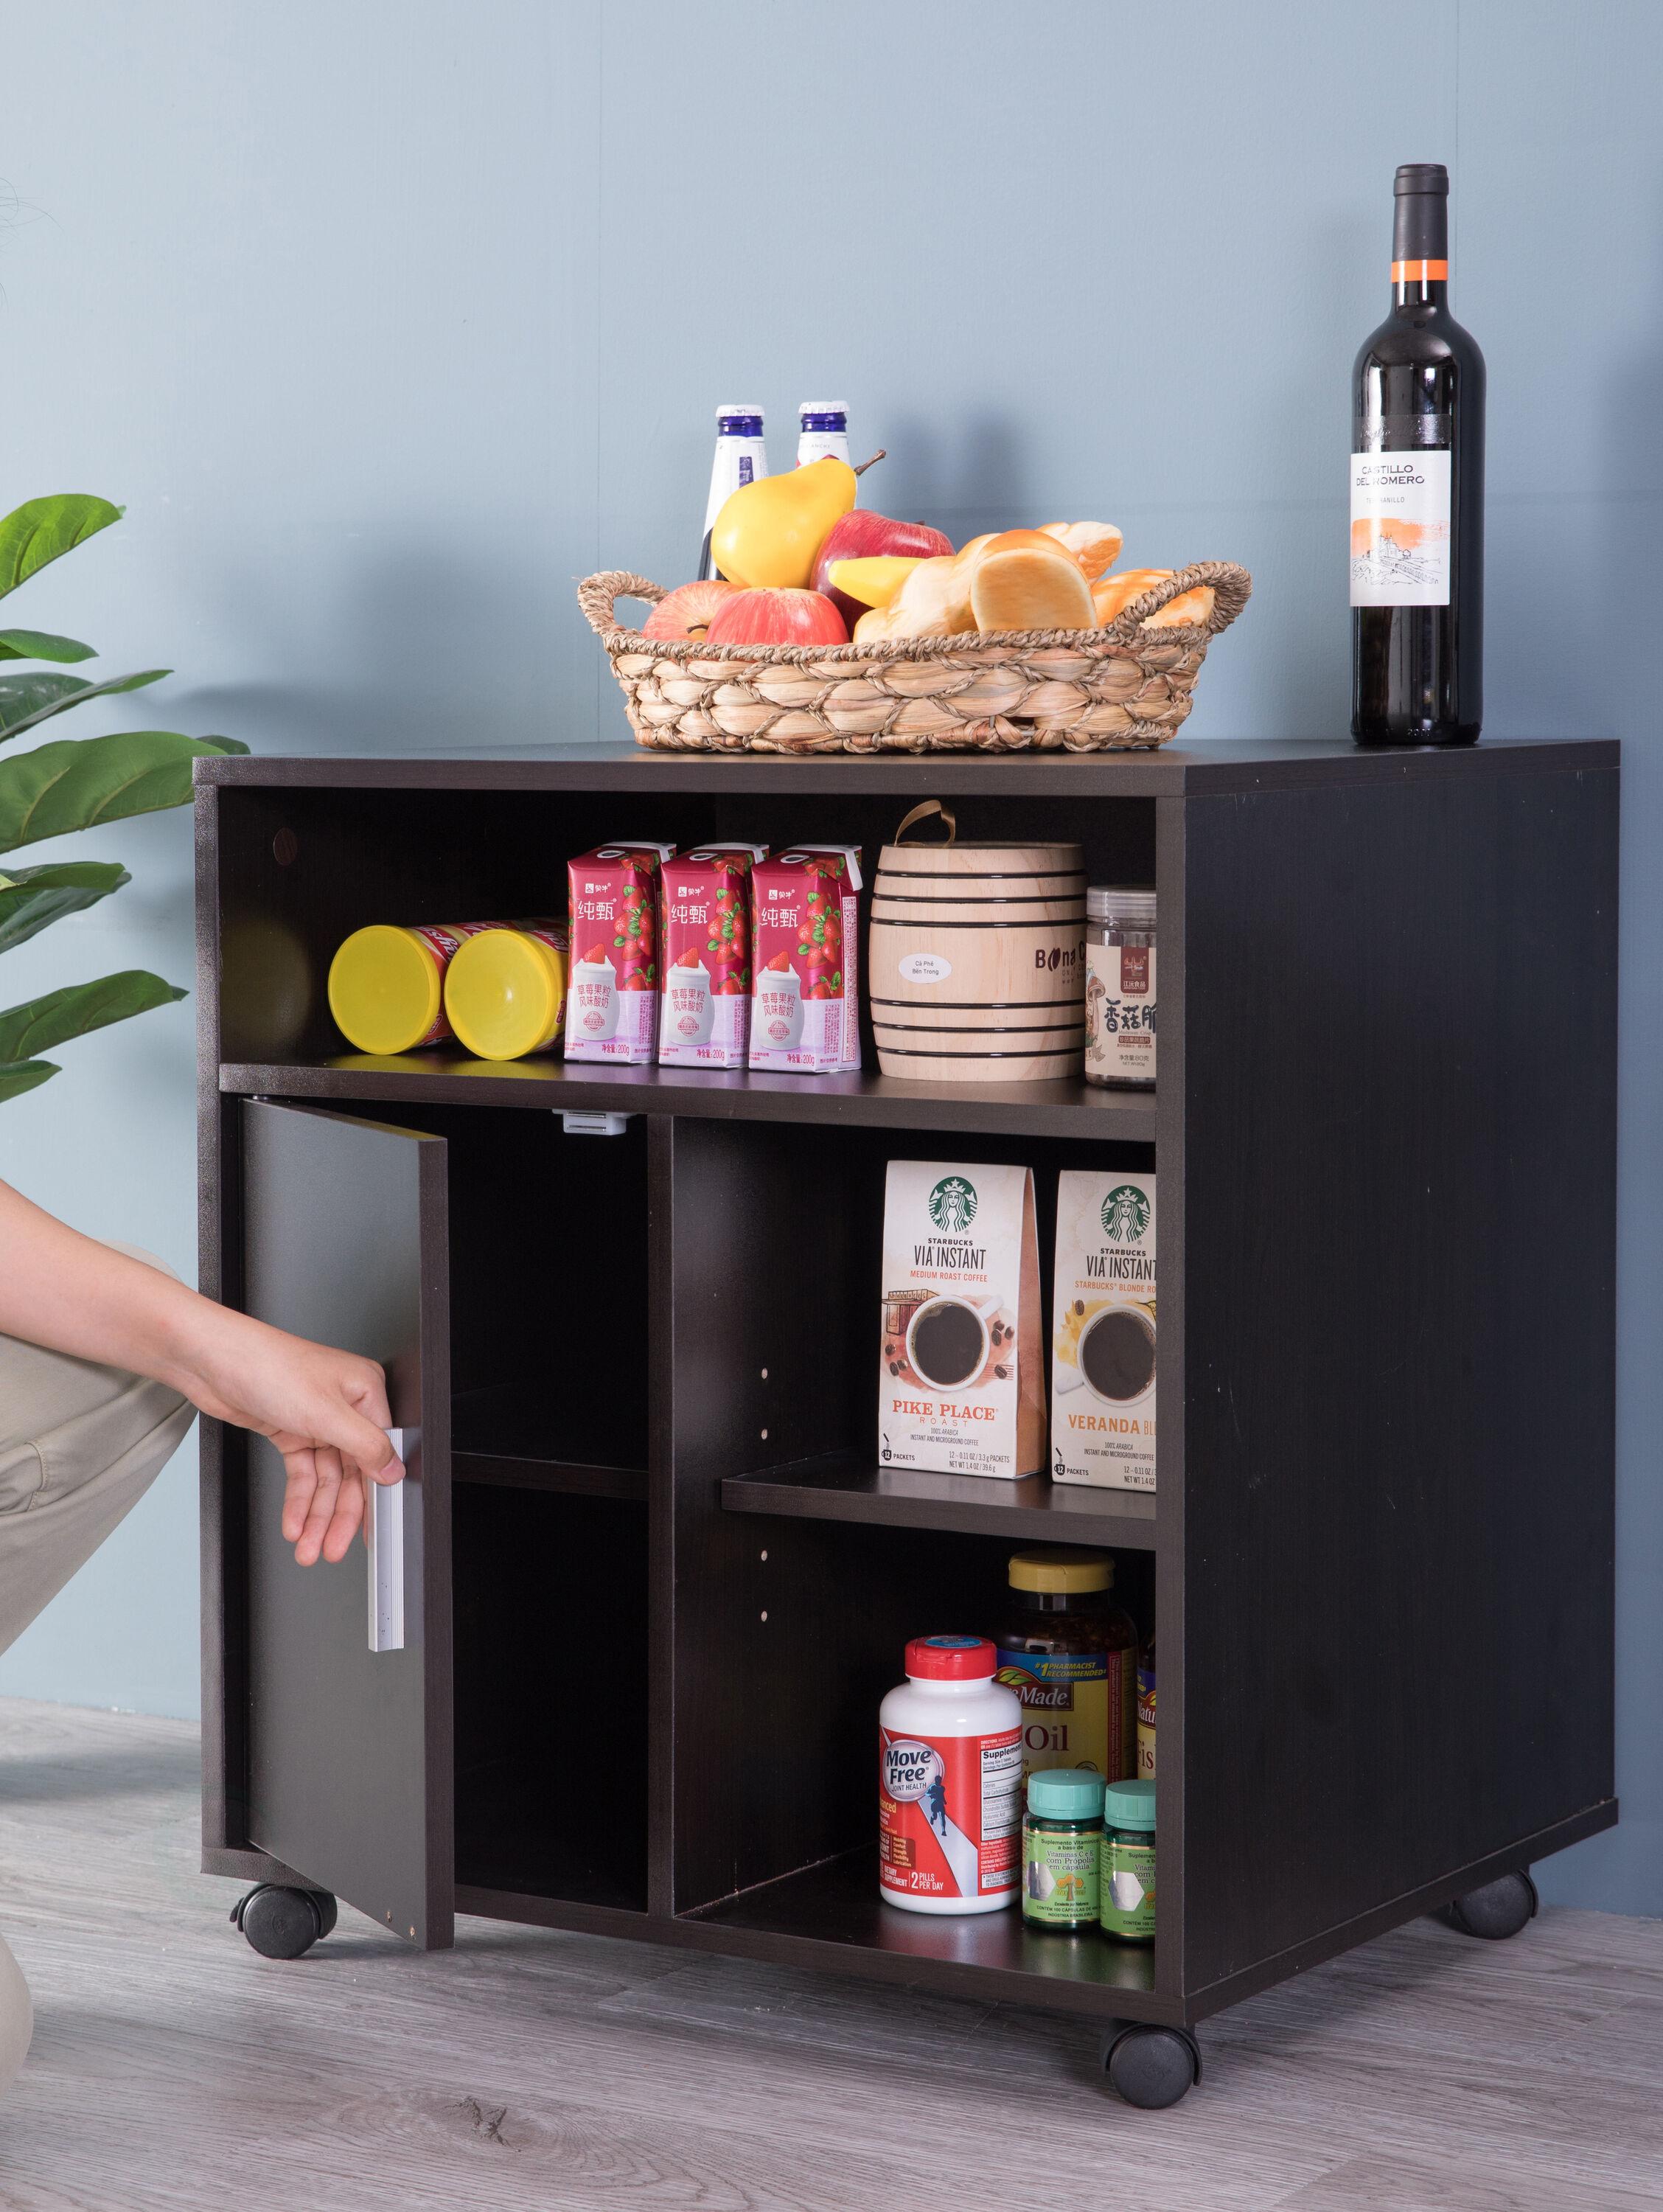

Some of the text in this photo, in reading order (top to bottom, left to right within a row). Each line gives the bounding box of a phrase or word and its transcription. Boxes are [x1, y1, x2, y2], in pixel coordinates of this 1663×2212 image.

[1356, 478, 1370, 486] DEL
[577, 900, 615, 920] 纯甄
[671, 904, 708, 925] 纯甄
[761, 908, 798, 928] 纯甄
[577, 984, 611, 998] 草莓果粒
[671, 989, 705, 1002] 草莓果粒
[579, 996, 609, 1009] 风味酸奶
[761, 992, 796, 1006] 草莓果粒
[674, 1001, 703, 1013] 风味酸奶
[764, 1004, 794, 1018] 风味酸奶
[928, 1238, 973, 1246] STARBUCKS
[914, 1245, 986, 1270] VIA INSTANT
[1100, 1248, 1146, 1256] STARBUCKS
[1087, 1255, 1105, 1278] VIA
[910, 1270, 988, 1282] MEDIUM ROAST COFFEE
[1075, 1281, 1114, 1290] STARBUCKS
[1119, 1284, 1145, 1293] BLONDE
[893, 1399, 995, 1421] PIKE PLACE
[920, 1416, 968, 1427] ROAST
[1068, 1414, 1140, 1435] VERANDA
[935, 1436, 964, 1445] MICROGROUND
[990, 1454, 1010, 1463] PACKETS
[1084, 1448, 1101, 1457] INSTANT
[1109, 1451, 1139, 1459] MICROGROUND
[1140, 1453, 1154, 1461] COFFEE
[1067, 1468, 1089, 1476] PACKETS
[1134, 1467, 1144, 1475] 0.11
[1124, 1475, 1132, 1484] NET
[1034, 1663, 1049, 1677] #1
[1047, 1669, 1104, 1677] RECOMMENDED
[1019, 1686, 1068, 1705] Made
[1025, 1725, 1070, 1751] Oil
[886, 1750, 932, 1767] Move
[890, 1767, 926, 1784] Free
[905, 1783, 927, 1791] HEALTH
[1047, 1850, 1078, 1858] Vitaminas
[1064, 1857, 1095, 1866] Própolis
[911, 1871, 918, 1889] 2
[919, 1872, 935, 1882] PILLS
[919, 1881, 944, 1891] PER DAY
